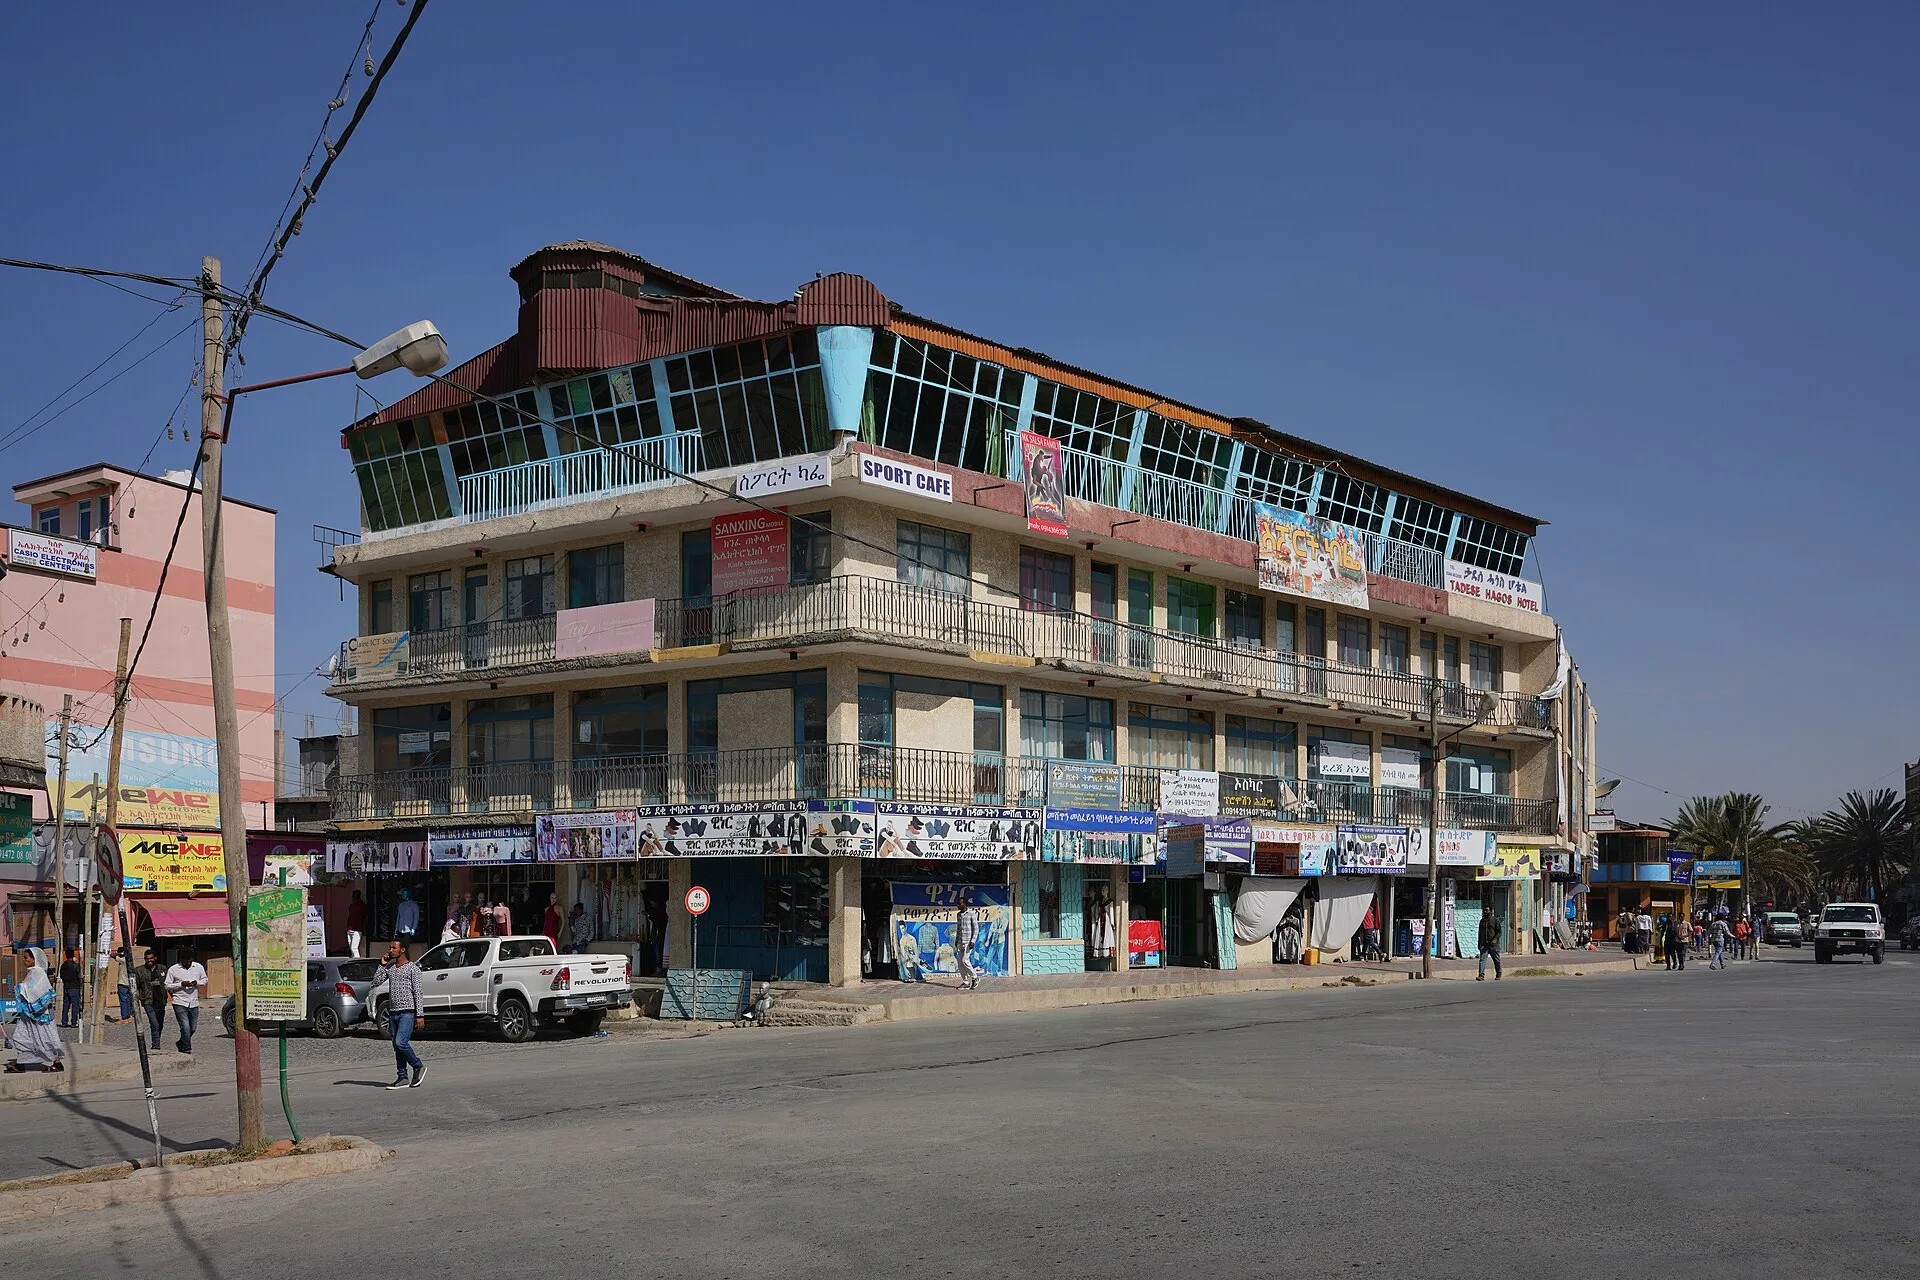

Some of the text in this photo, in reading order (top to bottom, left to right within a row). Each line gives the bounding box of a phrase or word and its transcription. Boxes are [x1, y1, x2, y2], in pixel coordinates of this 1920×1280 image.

[739, 464, 825, 491] ስፖርት ካፌ
[863, 459, 951, 496] SPORT CAFE
[715, 517, 784, 536] SANXING MOBILE
[14, 548, 39, 558] CASIO
[41, 553, 95, 570] ELECTRONIS
[39, 559, 72, 571] CENTER
[727, 561, 744, 569] Kinfe
[747, 566, 786, 575] Maintenance
[1449, 579, 1539, 613] TADESE HAGOS HOTEL
[348, 638, 369, 652] Claire
[370, 638, 381, 647] ICT
[150, 804, 212, 814] Electronics
[639, 807, 652, 816] ናይ
[654, 807, 666, 816] ደቂ
[763, 801, 786, 811] መሸጢ
[880, 803, 893, 812] ናይ
[896, 805, 909, 814] ደቂ
[1002, 809, 1023, 818] መሸጢ
[710, 816, 733, 830] ዊነር
[954, 819, 976, 833] ዊነር
[127, 841, 221, 856] MeWe
[685, 838, 757, 850] ዊነር የወንዶች ፋሽን
[835, 838, 853, 848] ዊነር
[928, 841, 997, 852] ዊነር የወንዶች ፋሽን
[830, 849, 873, 857] 0914-003677
[158, 864, 202, 873] ኤሌትሮኒክስ
[148, 873, 206, 882] Kasyo Electronics
[925, 883, 976, 906] ዊነር
[255, 971, 293, 979] ROMANAT
[574, 976, 624, 986] REVOLUTION
[251, 979, 299, 987] ELECTRONICS
